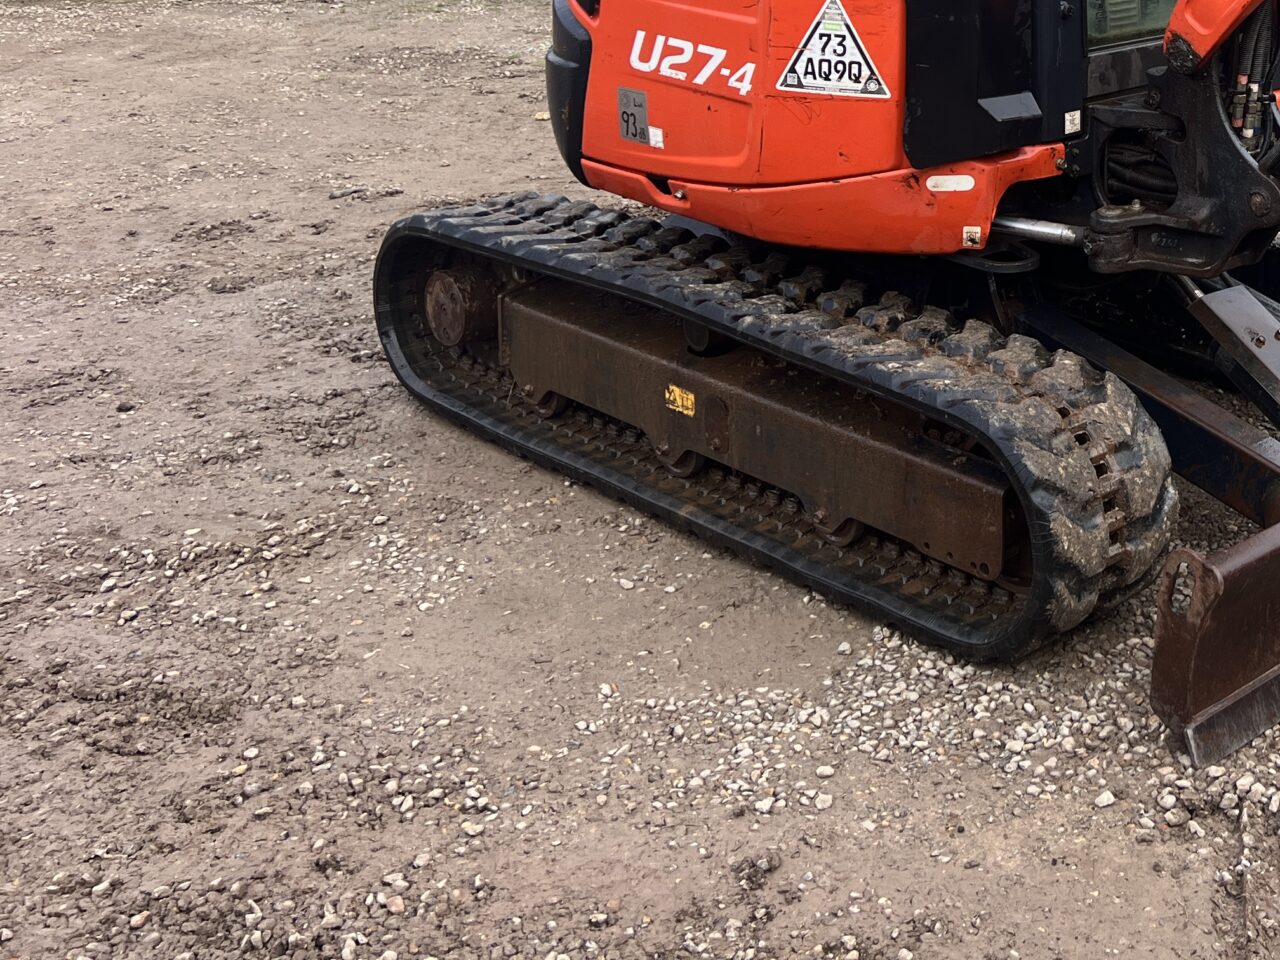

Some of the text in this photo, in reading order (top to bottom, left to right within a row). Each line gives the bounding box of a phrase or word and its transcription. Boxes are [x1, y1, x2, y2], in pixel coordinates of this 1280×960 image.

[819, 33, 847, 57] 73
[629, 30, 757, 96] U27-4
[803, 58, 862, 84] AQ9Q
[622, 111, 638, 138] 93
